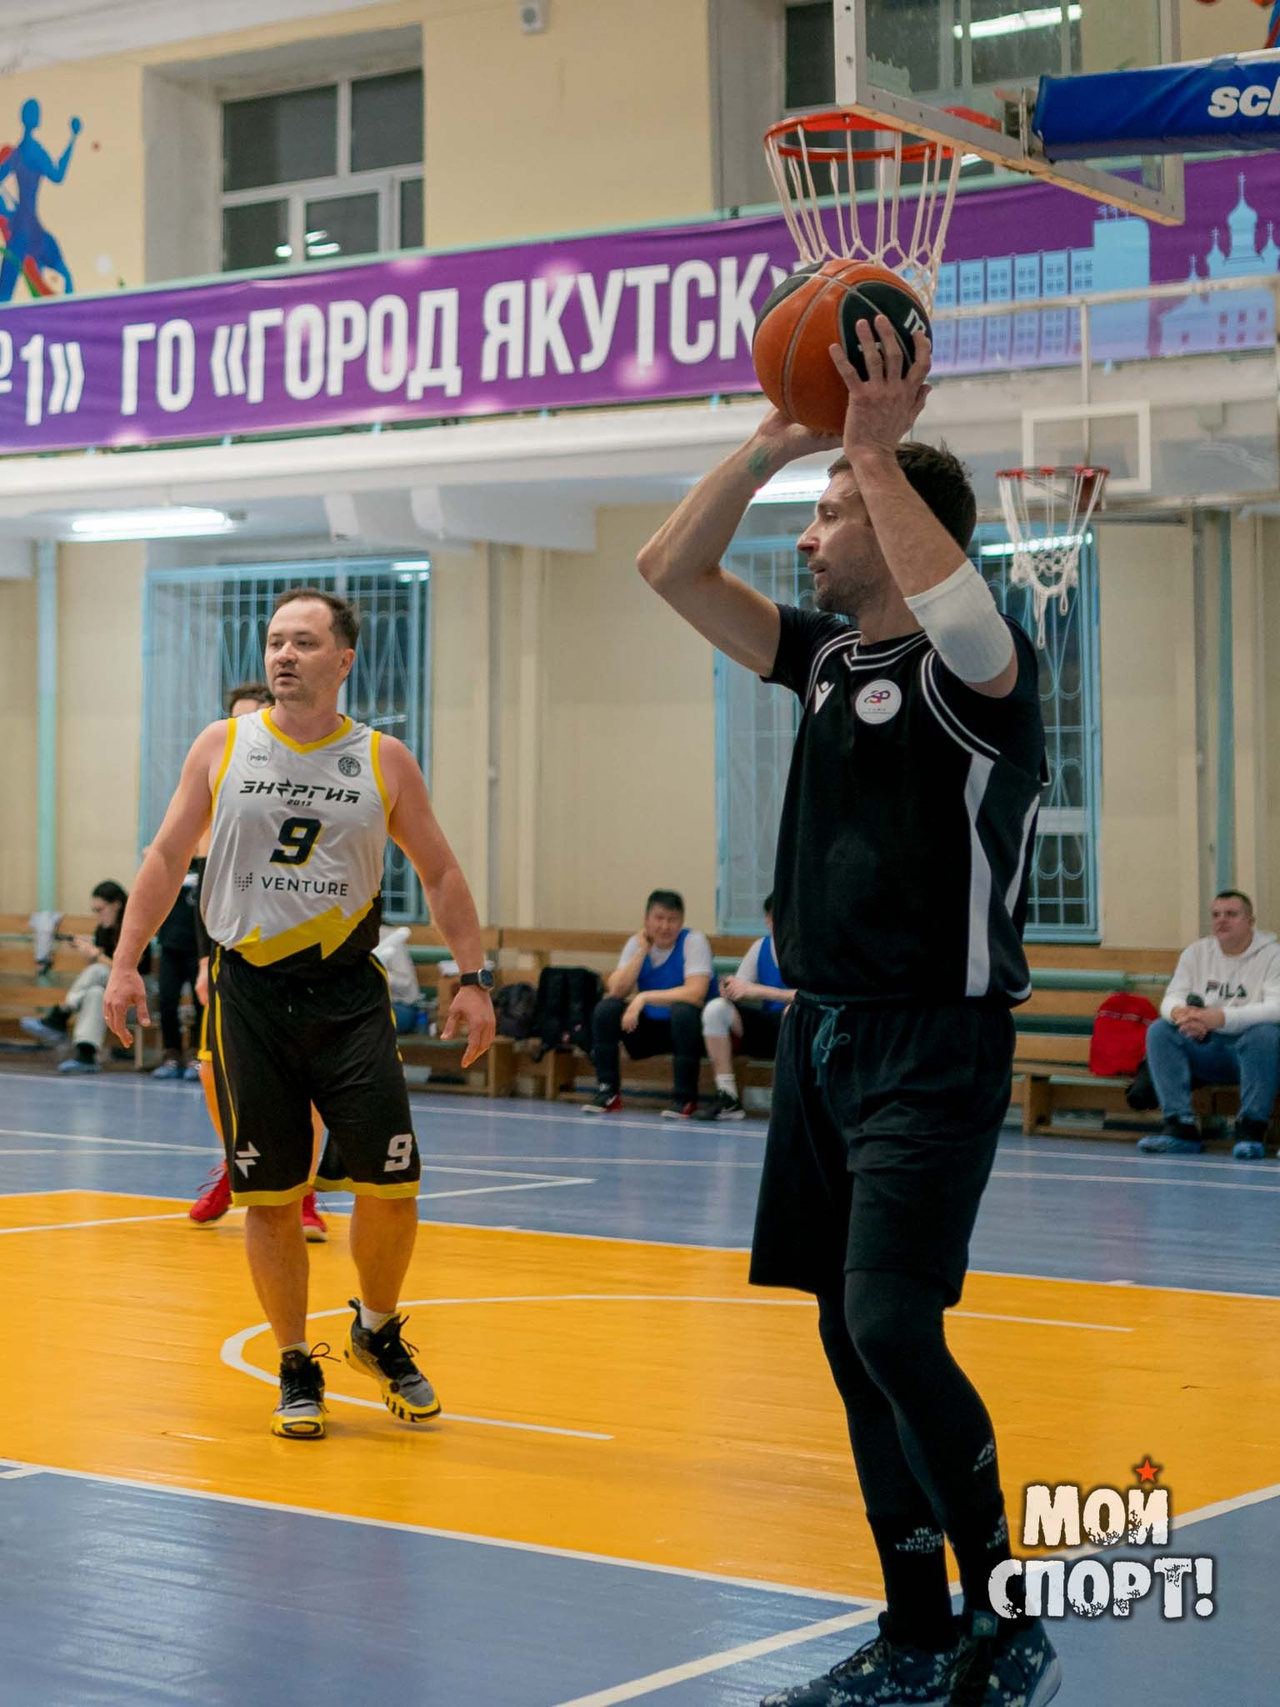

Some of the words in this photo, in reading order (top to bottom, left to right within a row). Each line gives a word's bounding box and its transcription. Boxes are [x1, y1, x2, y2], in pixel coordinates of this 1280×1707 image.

[122, 318, 197, 416] ГО
[209, 287, 462, 404] «ГОРОД
[269, 816, 323, 868] 9
[261, 876, 349, 897] VENTURE
[384, 1133, 414, 1173] 9
